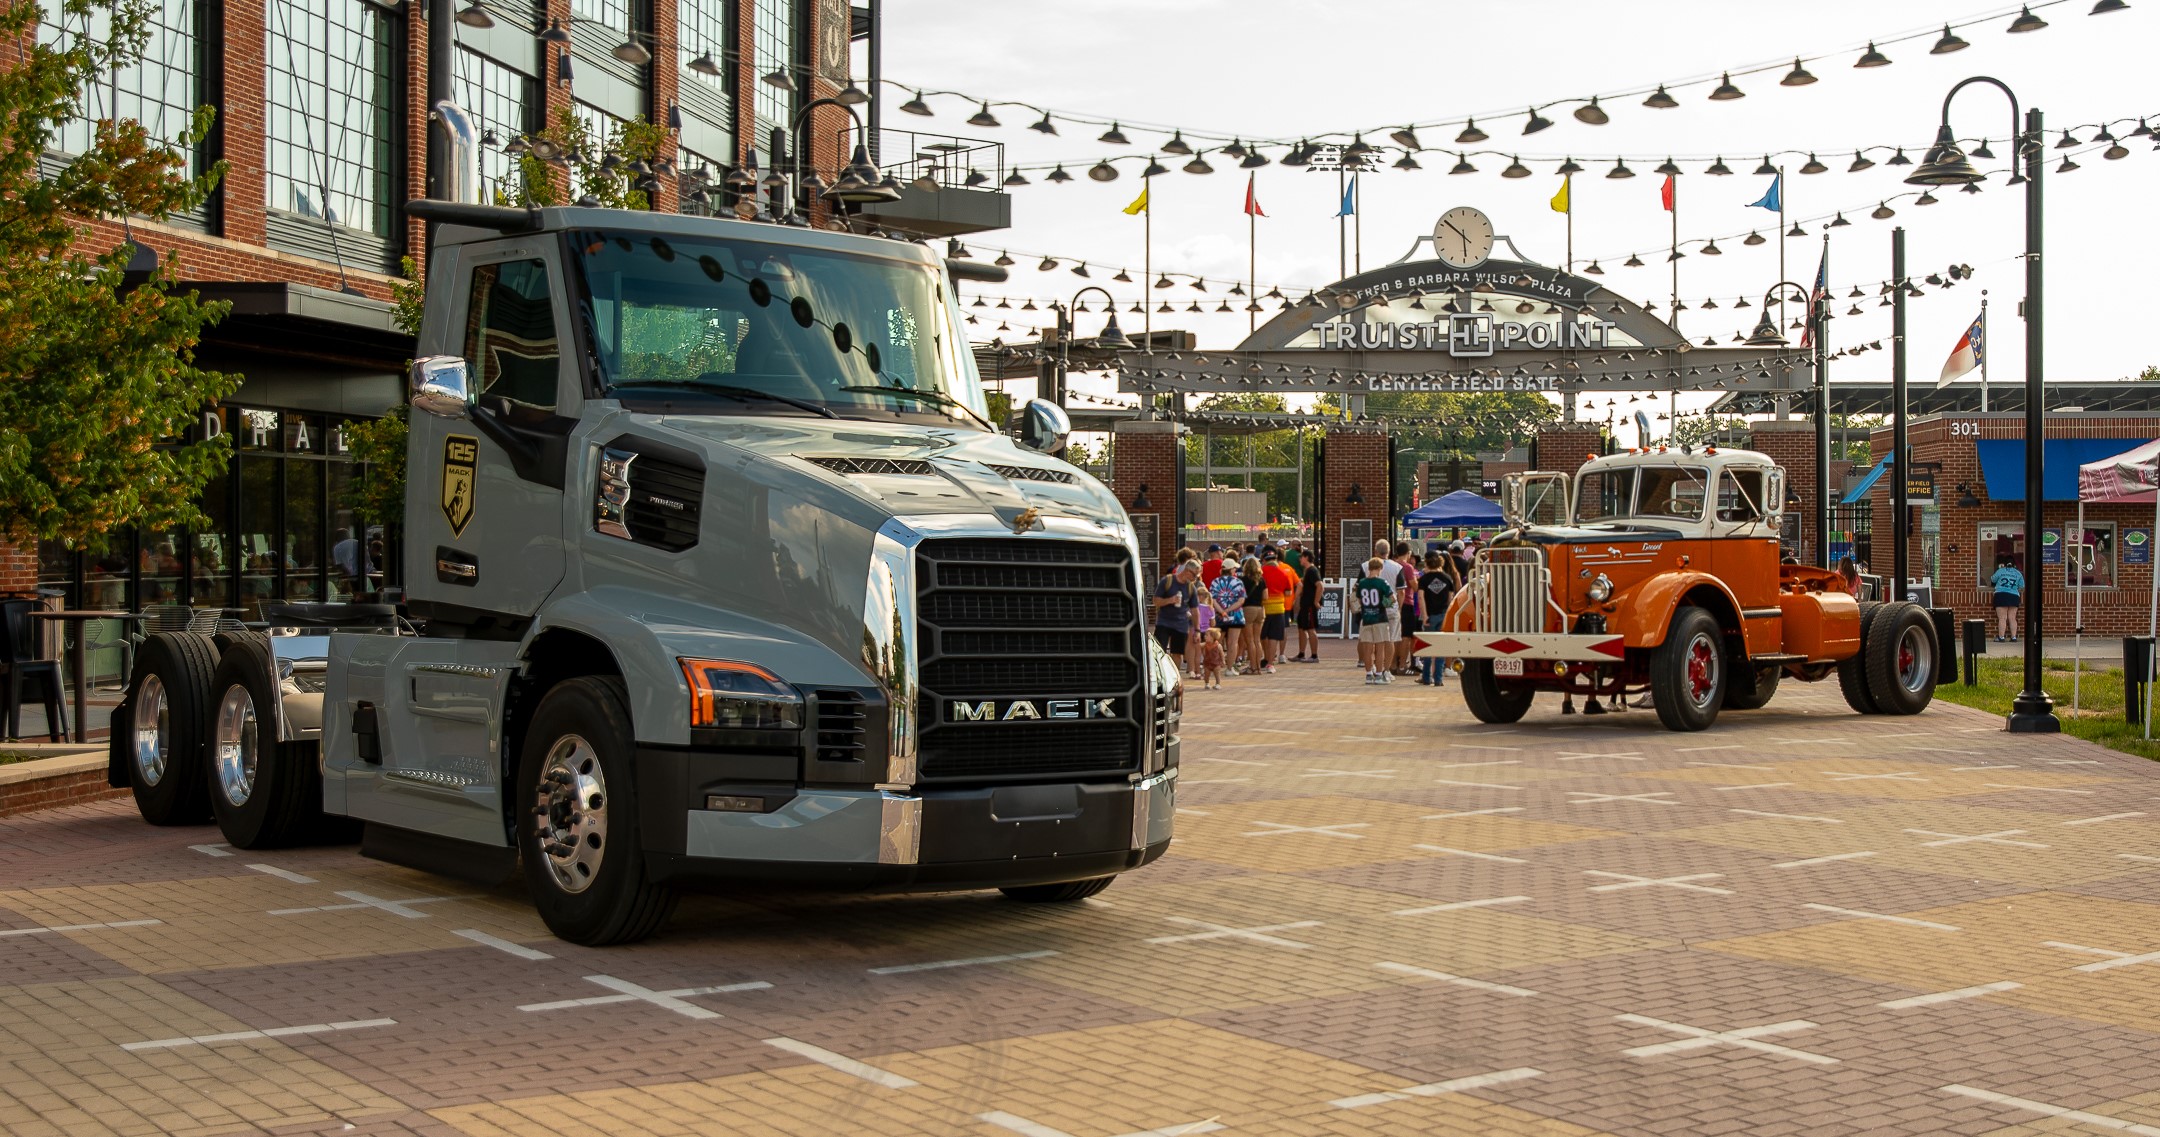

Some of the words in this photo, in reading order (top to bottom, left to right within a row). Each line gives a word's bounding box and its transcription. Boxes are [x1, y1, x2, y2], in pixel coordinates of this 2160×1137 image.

[1357, 282, 1389, 299] FRED
[1395, 280, 1403, 289] &
[1408, 272, 1469, 287] BARBARA
[1475, 272, 1517, 285] WILSO
[1531, 279, 1572, 298] PLAZA
[1312, 322, 1439, 349] TRUIST
[1502, 322, 1616, 349] POINT
[1451, 376, 1504, 391] FIELD
[1512, 376, 1559, 391] GATE
[1951, 422, 1981, 436] 301
[448, 442, 476, 462] 125
[448, 468, 471, 476] MACK
[2000, 577, 2017, 587] 27
[1361, 588, 1380, 606] 80
[953, 698, 1116, 721] MACK
